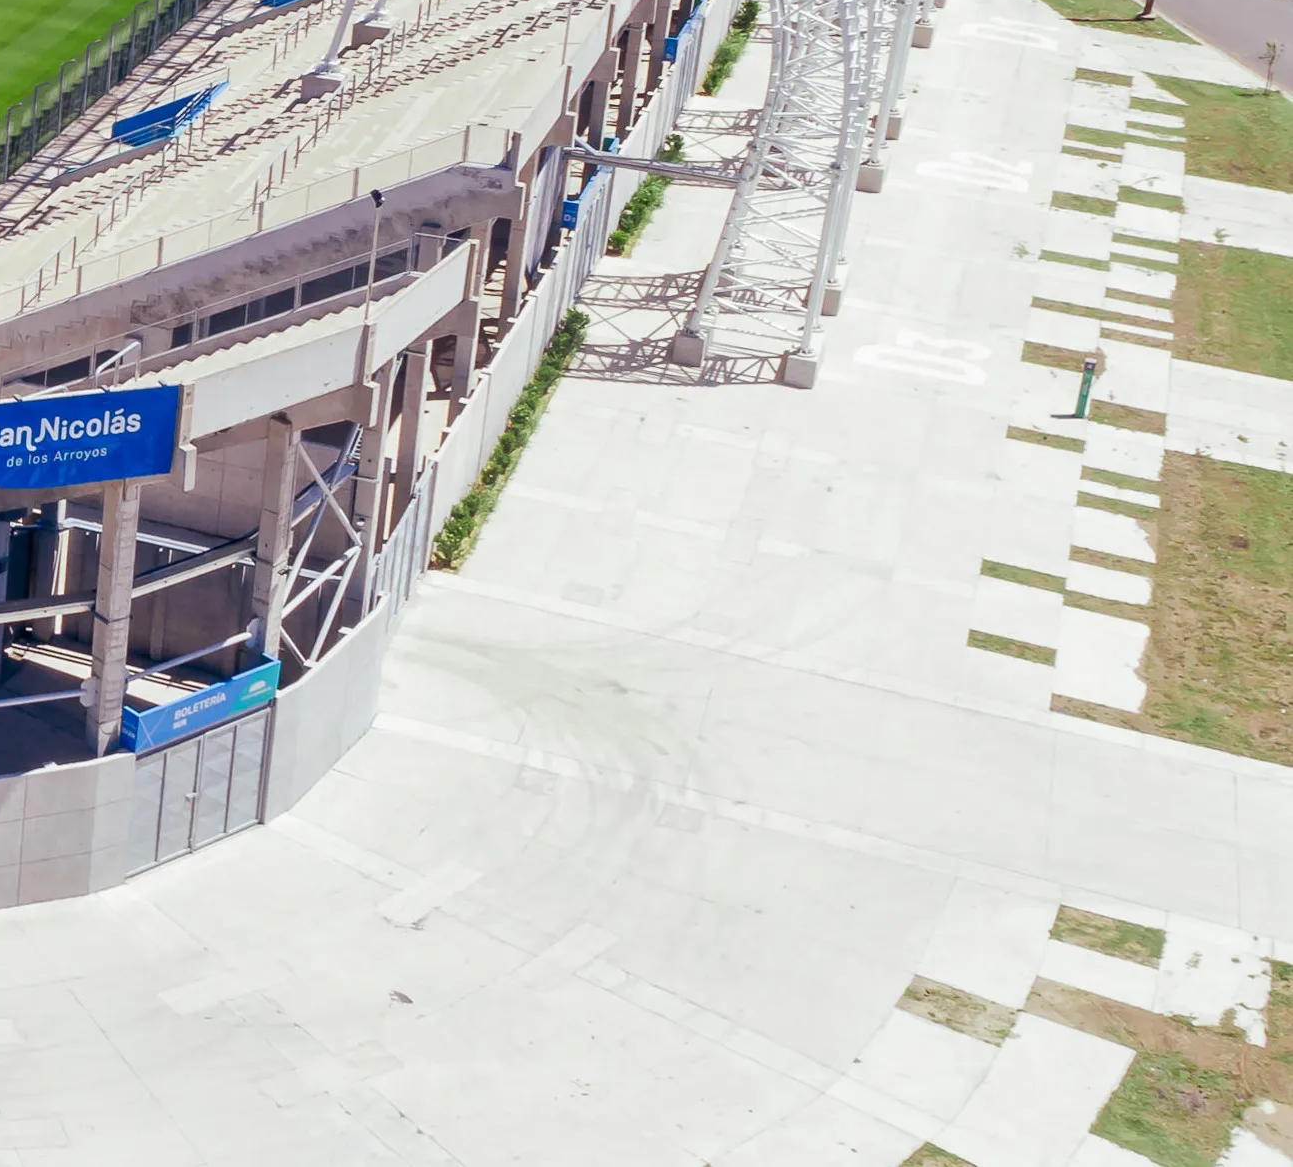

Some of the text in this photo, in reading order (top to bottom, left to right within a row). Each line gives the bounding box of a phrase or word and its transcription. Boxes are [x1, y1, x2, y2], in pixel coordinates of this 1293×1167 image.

[34, 407, 143, 444] Nicolás
[5, 446, 108, 469] de los Arroyos
[173, 691, 227, 720] BOLETERÍA
